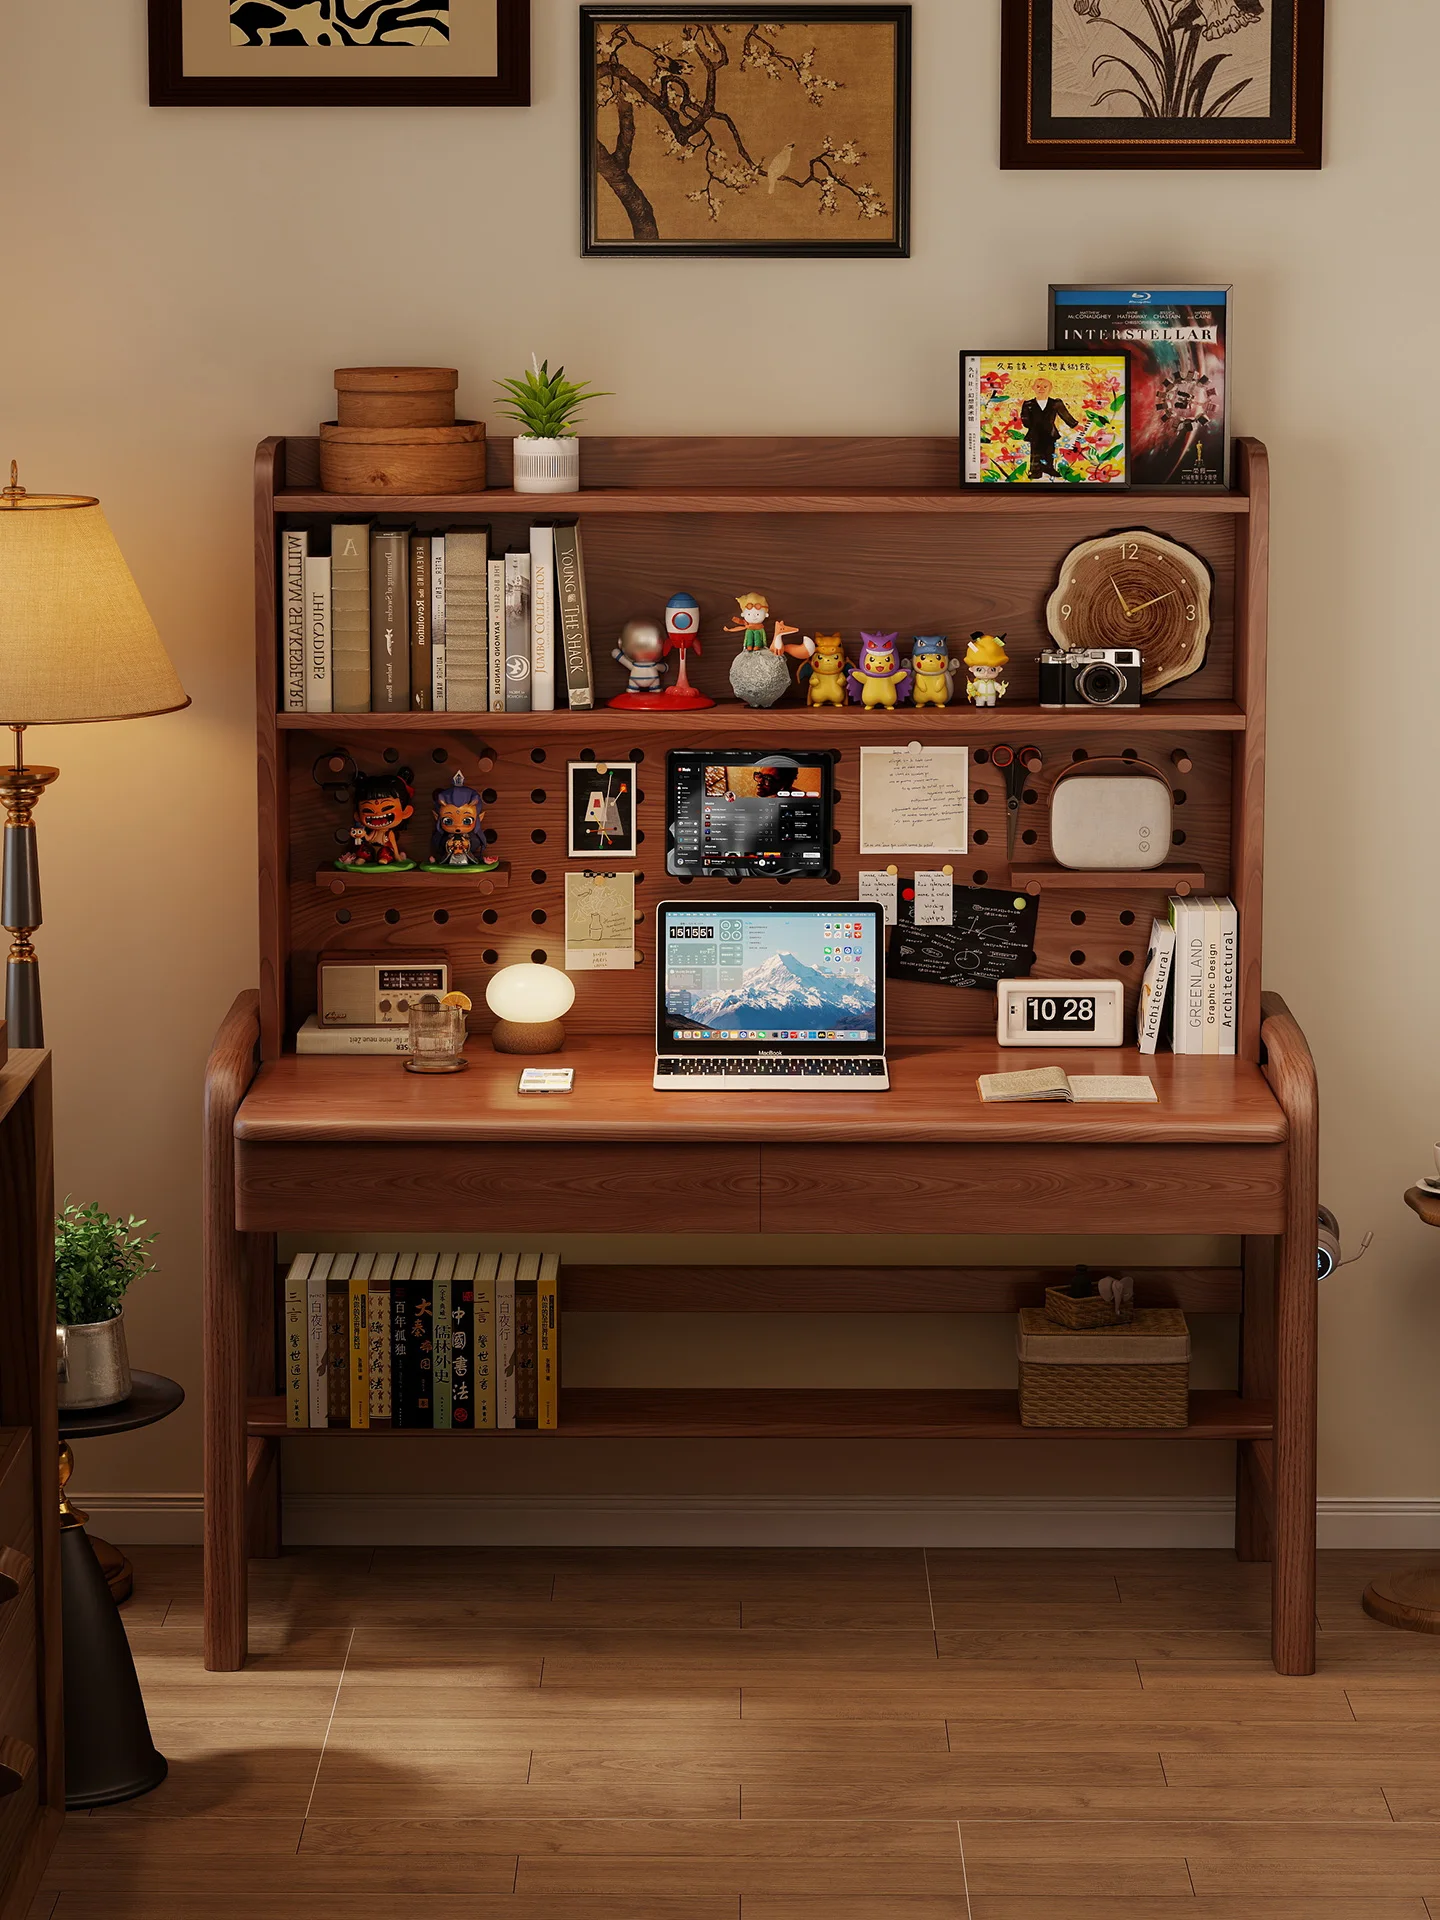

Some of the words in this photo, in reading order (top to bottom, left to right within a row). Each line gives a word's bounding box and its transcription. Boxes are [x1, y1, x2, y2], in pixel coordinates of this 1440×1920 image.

[1064, 329, 1212, 340] INTERSTELLAR
[560, 548, 577, 593] YOUNG
[1119, 543, 1139, 560] 12
[564, 605, 580, 631] THE
[1061, 604, 1072, 621] 9
[1186, 605, 1196, 621] 3
[566, 633, 584, 674] SHACK
[1207, 943, 1218, 979] Design
[1222, 931, 1234, 1028] Architectural
[1146, 951, 1170, 1039] Architectural
[1189, 938, 1203, 1028] GREENLAND
[1207, 980, 1218, 1024] Graphic
[1028, 998, 1056, 1021] 10
[1062, 998, 1094, 1021] 28
[310, 1300, 323, 1340] 白夜行
[394, 1300, 407, 1356] 百年孤独
[498, 1301, 511, 1341] 白夜行
[433, 1324, 451, 1384] 儒林外史
[451, 1306, 469, 1401] 中國書法
